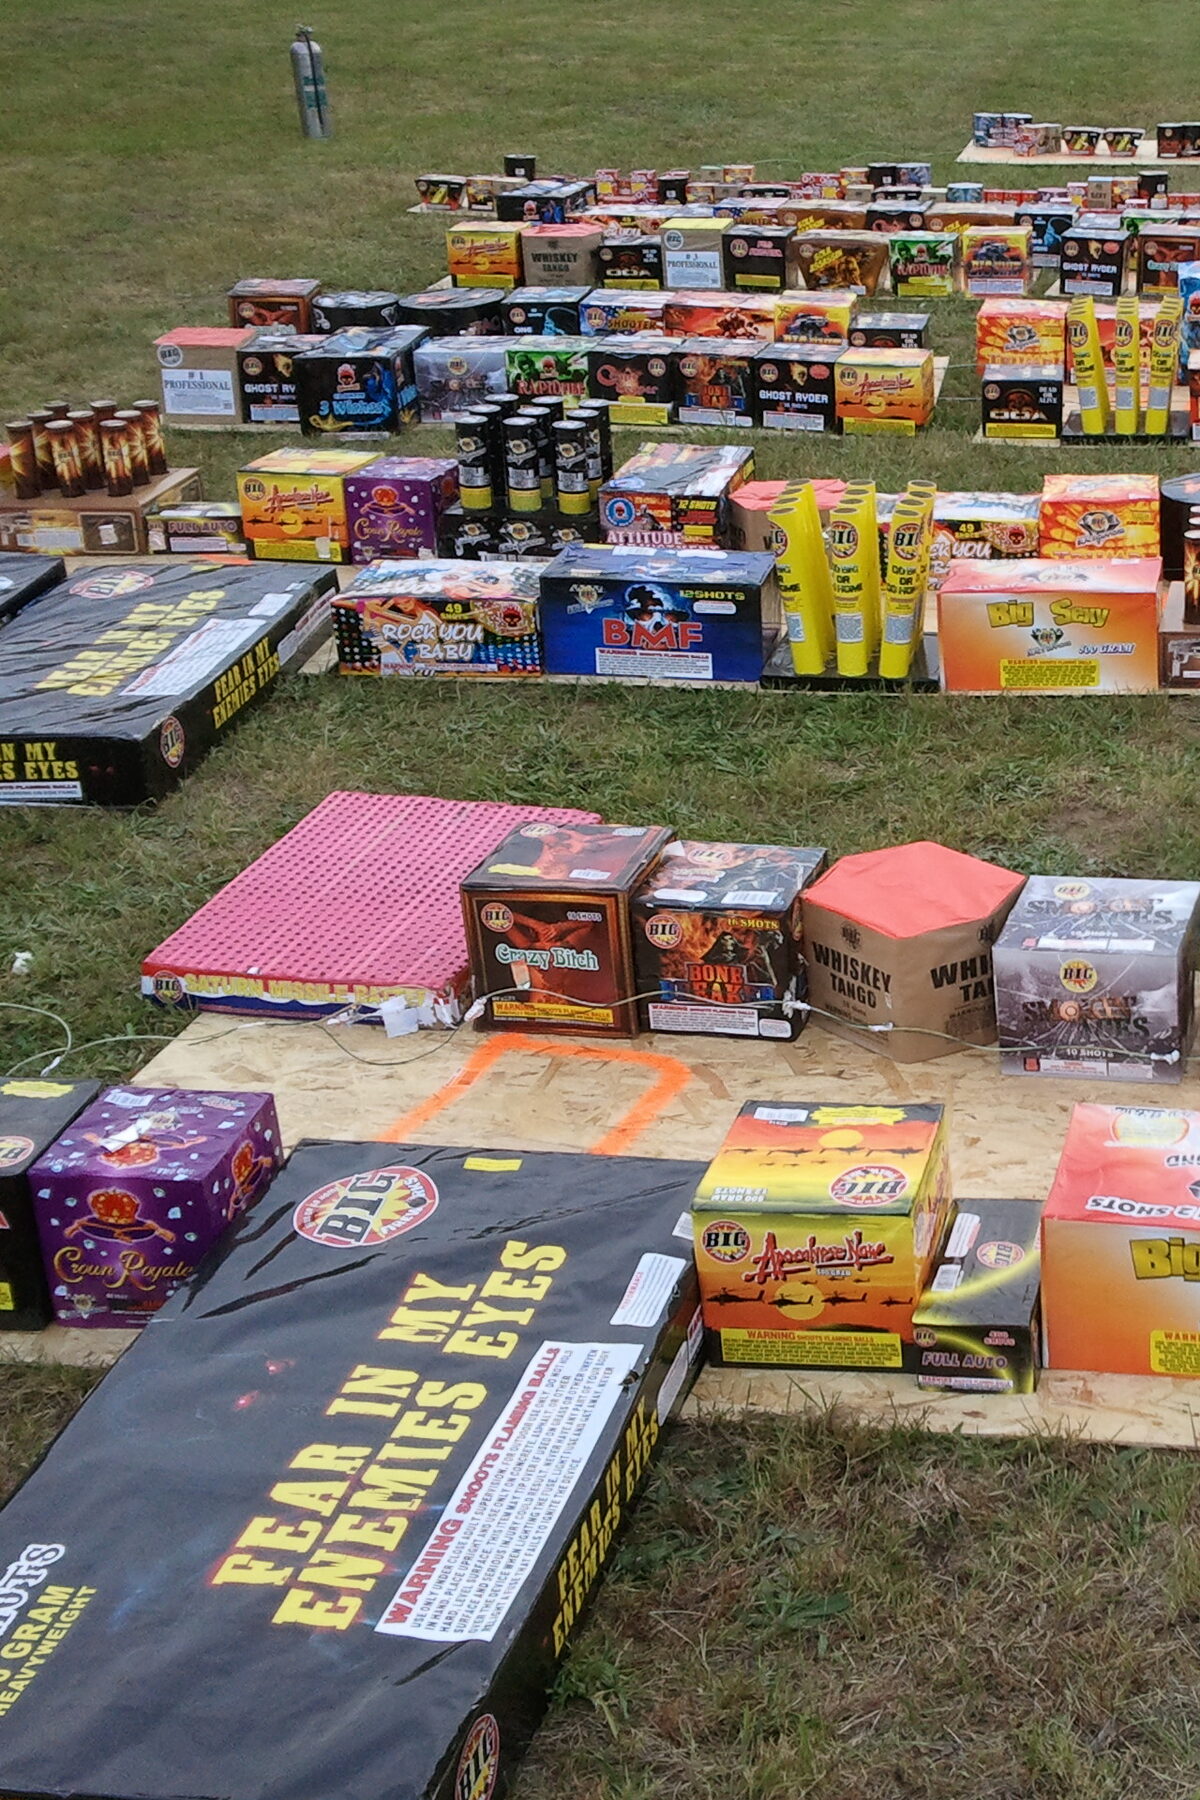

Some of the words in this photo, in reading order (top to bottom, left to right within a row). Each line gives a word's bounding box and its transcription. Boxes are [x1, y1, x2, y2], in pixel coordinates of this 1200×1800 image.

[531, 253, 578, 263] WHISKEY
[667, 260, 718, 269] PROFESSIONAL
[1063, 263, 1088, 272] GHOST
[1091, 264, 1117, 274] RYDER
[608, 319, 658, 331] SHOOTER
[164, 380, 231, 391] PROFESSIONAL
[244, 384, 279, 394] GHOST
[759, 389, 792, 401] GHOST
[796, 391, 829, 404] RYDER
[333, 401, 386, 416] Wishes
[168, 520, 198, 533] FULL
[201, 520, 237, 533] AUTO
[959, 523, 974, 533] 49
[607, 530, 683, 545] ATTITUDE
[953, 541, 990, 558] YOU
[444, 603, 463, 613] 49
[987, 600, 1034, 628] Big
[1050, 598, 1110, 628] Sexy
[383, 622, 437, 641] ROCK
[439, 622, 484, 641] YOU
[602, 618, 703, 649] BMF
[417, 643, 475, 660] BABY
[214, 663, 244, 702] FEAR
[25, 742, 57, 762] MY
[25, 761, 79, 780] EYES
[485, 909, 511, 921] BIG
[740, 919, 779, 929] SHOTS
[649, 923, 678, 936] BIG
[495, 943, 550, 970] Crazy
[550, 947, 600, 971] Bitch
[689, 964, 743, 984] BONE
[811, 941, 893, 994] WHISKEY
[1062, 967, 1095, 980] BIG
[155, 979, 180, 991] BIG
[185, 974, 265, 998] SATURN
[268, 980, 346, 1001] MISSILE
[830, 972, 877, 1009] TANGO
[495, 1002, 535, 1012] WARNING
[313, 1173, 400, 1245] BIG
[1085, 1196, 1173, 1218] SHOTS
[706, 1231, 747, 1248] BIG
[742, 1231, 846, 1285] Apocalypse
[844, 1228, 894, 1271] Now
[53, 1246, 115, 1283] Crown
[102, 1250, 194, 1291] Royale
[747, 1330, 795, 1341] WARNING
[922, 1352, 960, 1367] FULL
[962, 1355, 1008, 1369] AUTO
[210, 1443, 372, 1588] FEAR
[325, 1364, 422, 1419] IN
[377, 1273, 477, 1344] MY
[271, 1380, 488, 1632] ENEMIES
[442, 1240, 567, 1360] EYES
[384, 1519, 465, 1624] WARNING
[455, 1452, 500, 1515] SHOOTS
[491, 1390, 537, 1451] FLAMING
[527, 1347, 562, 1388] BALLS
[551, 1489, 621, 1660] ENEMIES
[624, 1407, 660, 1503] EYES
[557, 1498, 602, 1605] FEAR
[433, 1563, 454, 1590] UNDER
[0, 1585, 76, 1660] GRAM
[0, 1585, 98, 1718] HEAVYWEIGHT
